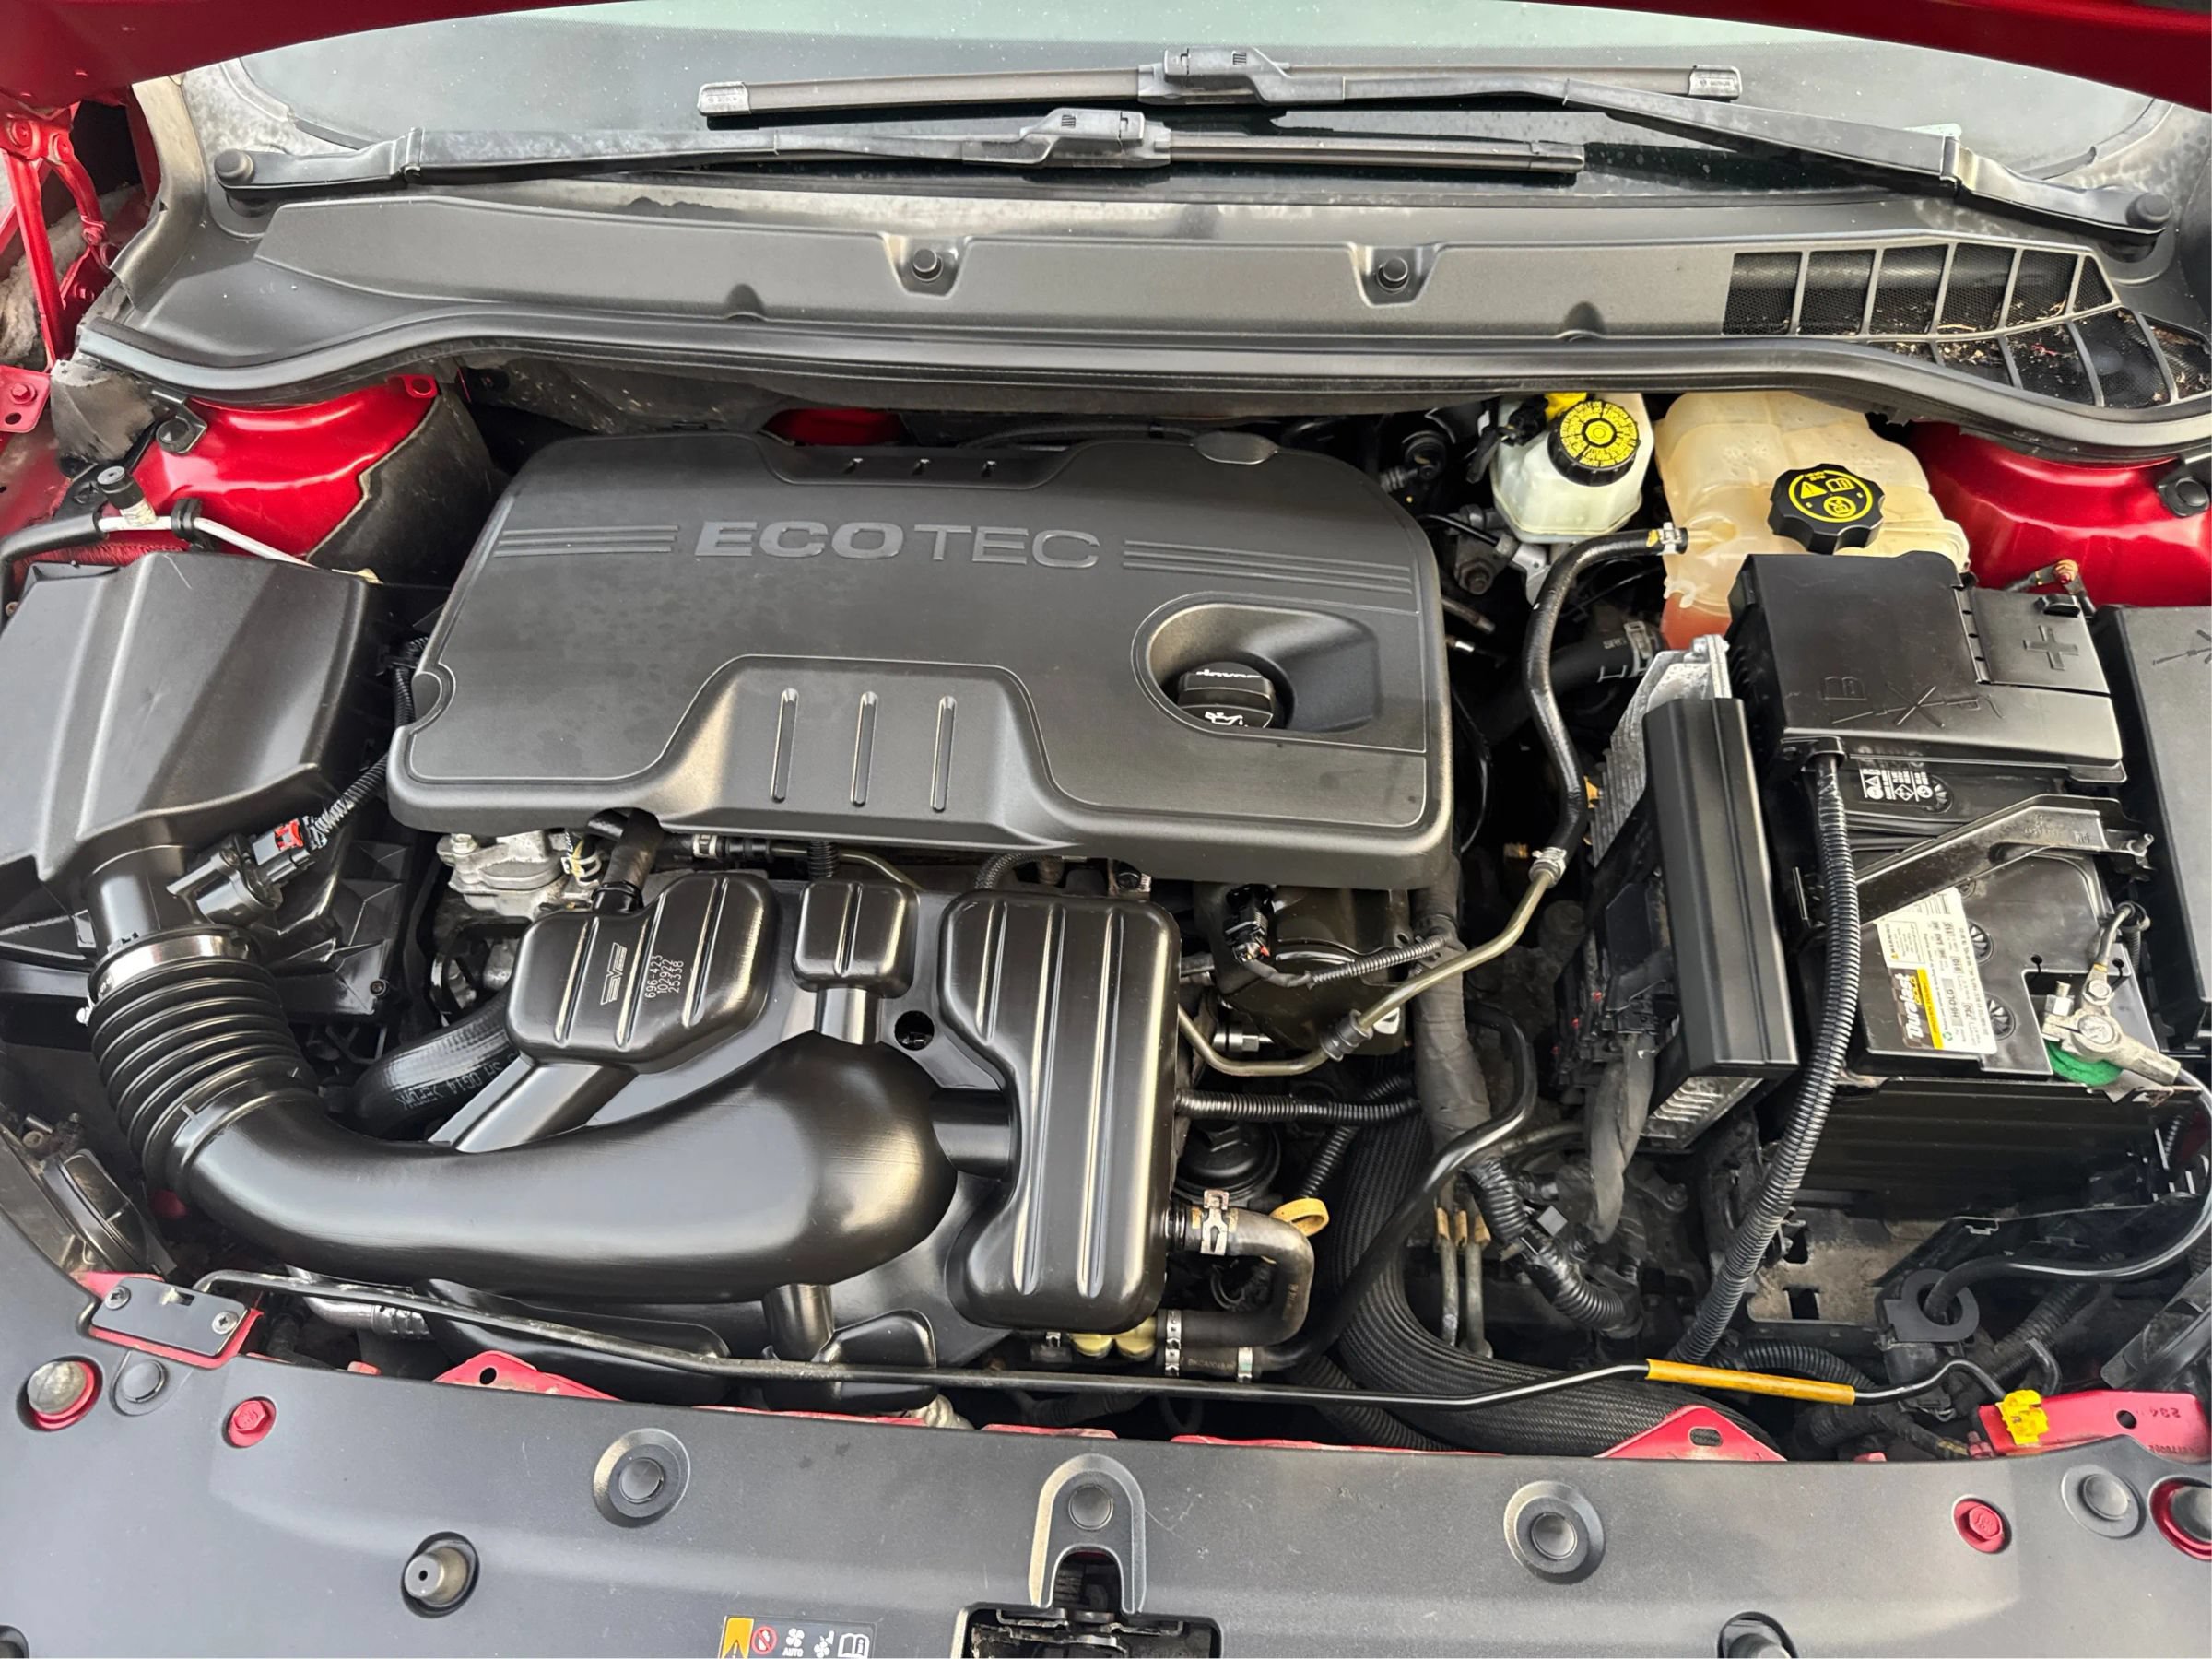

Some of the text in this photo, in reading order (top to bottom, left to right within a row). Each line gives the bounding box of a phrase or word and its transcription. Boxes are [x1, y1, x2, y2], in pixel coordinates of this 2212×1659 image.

[695, 521, 1100, 569] ECOTEC
[645, 955, 663, 998] 696-423
[657, 959, 674, 994] 102922
[668, 961, 684, 993] 25338
[1892, 972, 1924, 1039] Duralast
[782, 1648, 804, 1657] AUTO
